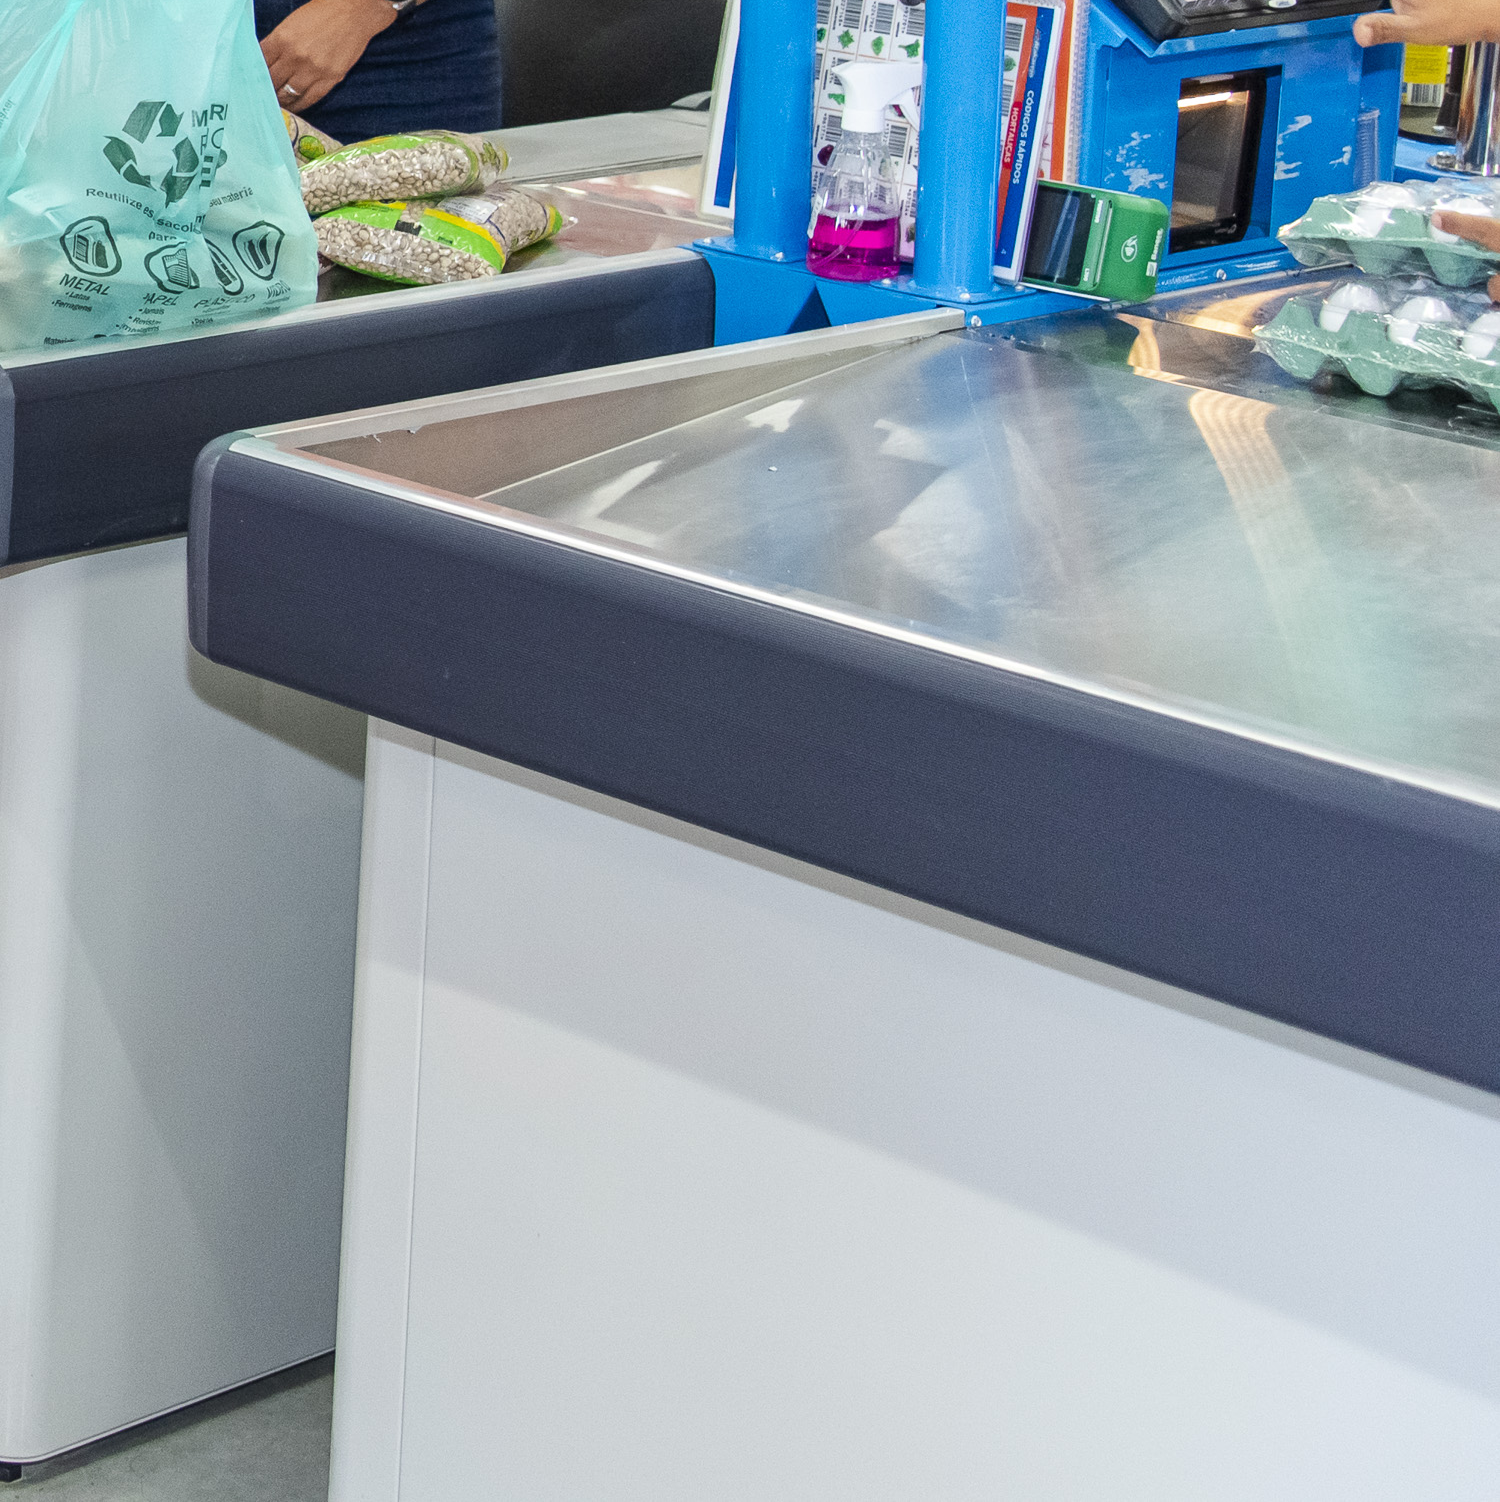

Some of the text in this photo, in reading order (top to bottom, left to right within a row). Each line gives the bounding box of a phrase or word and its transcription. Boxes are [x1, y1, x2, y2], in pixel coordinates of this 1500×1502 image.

[1003, 106, 1020, 164] HORTALIÇAS
[1012, 89, 1036, 185] CÓDIGOS RÁPIDOS
[86, 187, 143, 212] Reutilize
[59, 273, 112, 297] METAL
[53, 299, 93, 313] Ferragens
